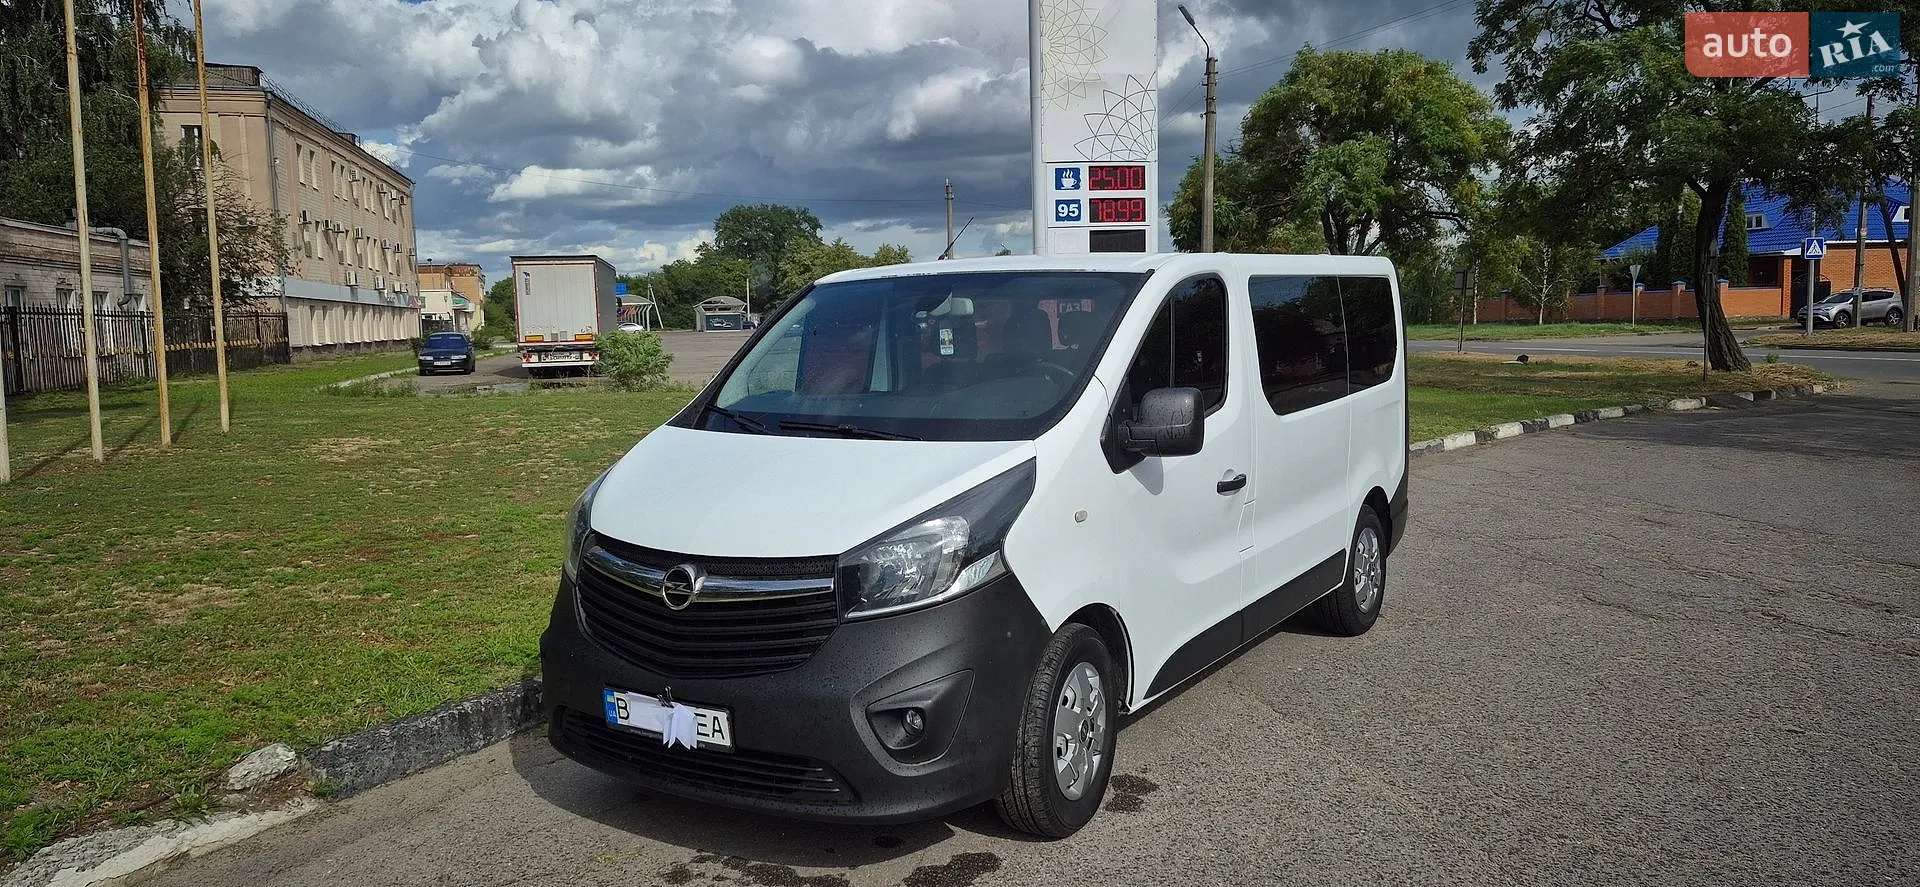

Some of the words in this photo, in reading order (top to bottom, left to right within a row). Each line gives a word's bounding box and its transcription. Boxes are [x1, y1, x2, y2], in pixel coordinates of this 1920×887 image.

[1090, 167, 1143, 190] 25.00
[1057, 204, 1079, 217] 95
[1091, 199, 1143, 222] 78.99
[1059, 302, 1081, 312] ГАЗ
[608, 709, 617, 717] UA
[616, 697, 629, 720] B
[694, 712, 725, 740] EA
